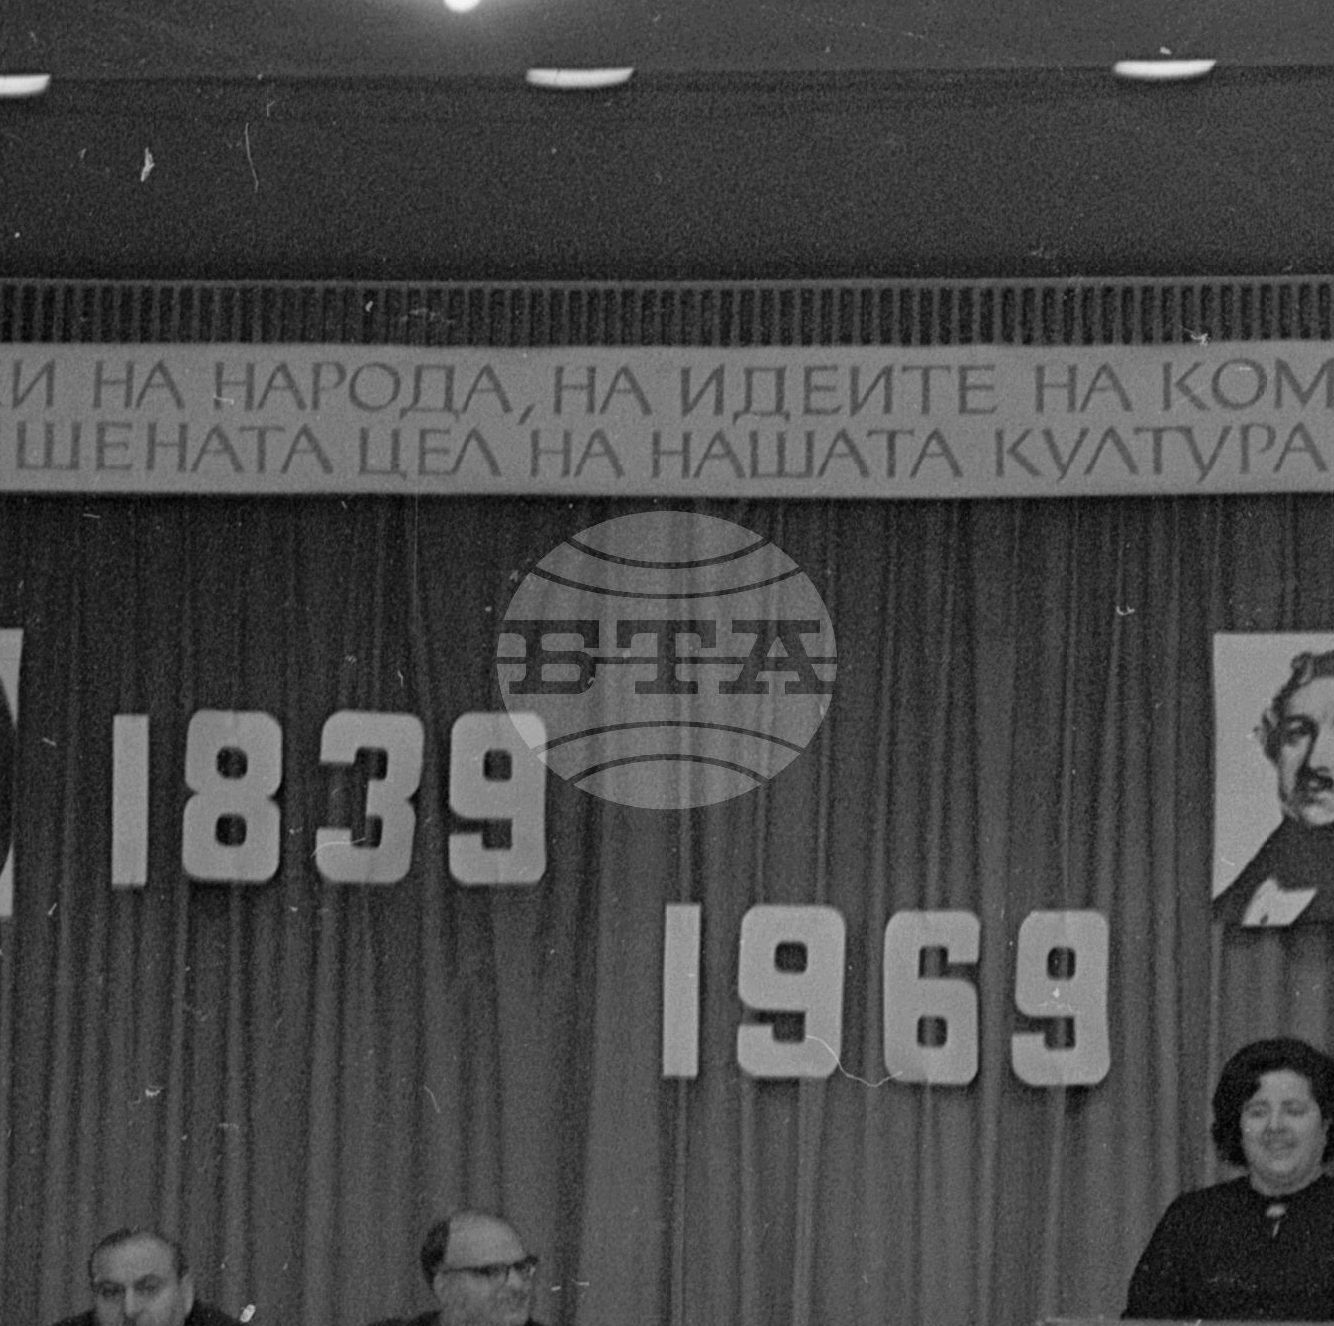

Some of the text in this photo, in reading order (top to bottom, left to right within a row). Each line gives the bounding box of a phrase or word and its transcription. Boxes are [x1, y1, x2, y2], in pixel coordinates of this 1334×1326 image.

[93, 358, 185, 410] НА
[214, 360, 535, 425] НАРОДА,
[554, 363, 652, 416] НА
[680, 363, 999, 425] ИДЕИТЕ
[1034, 361, 1133, 413] НА
[358, 424, 503, 481] ЦЕЛ
[529, 427, 625, 478] НА
[651, 426, 964, 479] НАШАТА
[994, 422, 1330, 483] КУЛТУРА
[110, 709, 547, 887] 1839
[663, 903, 1111, 1087] 1969
